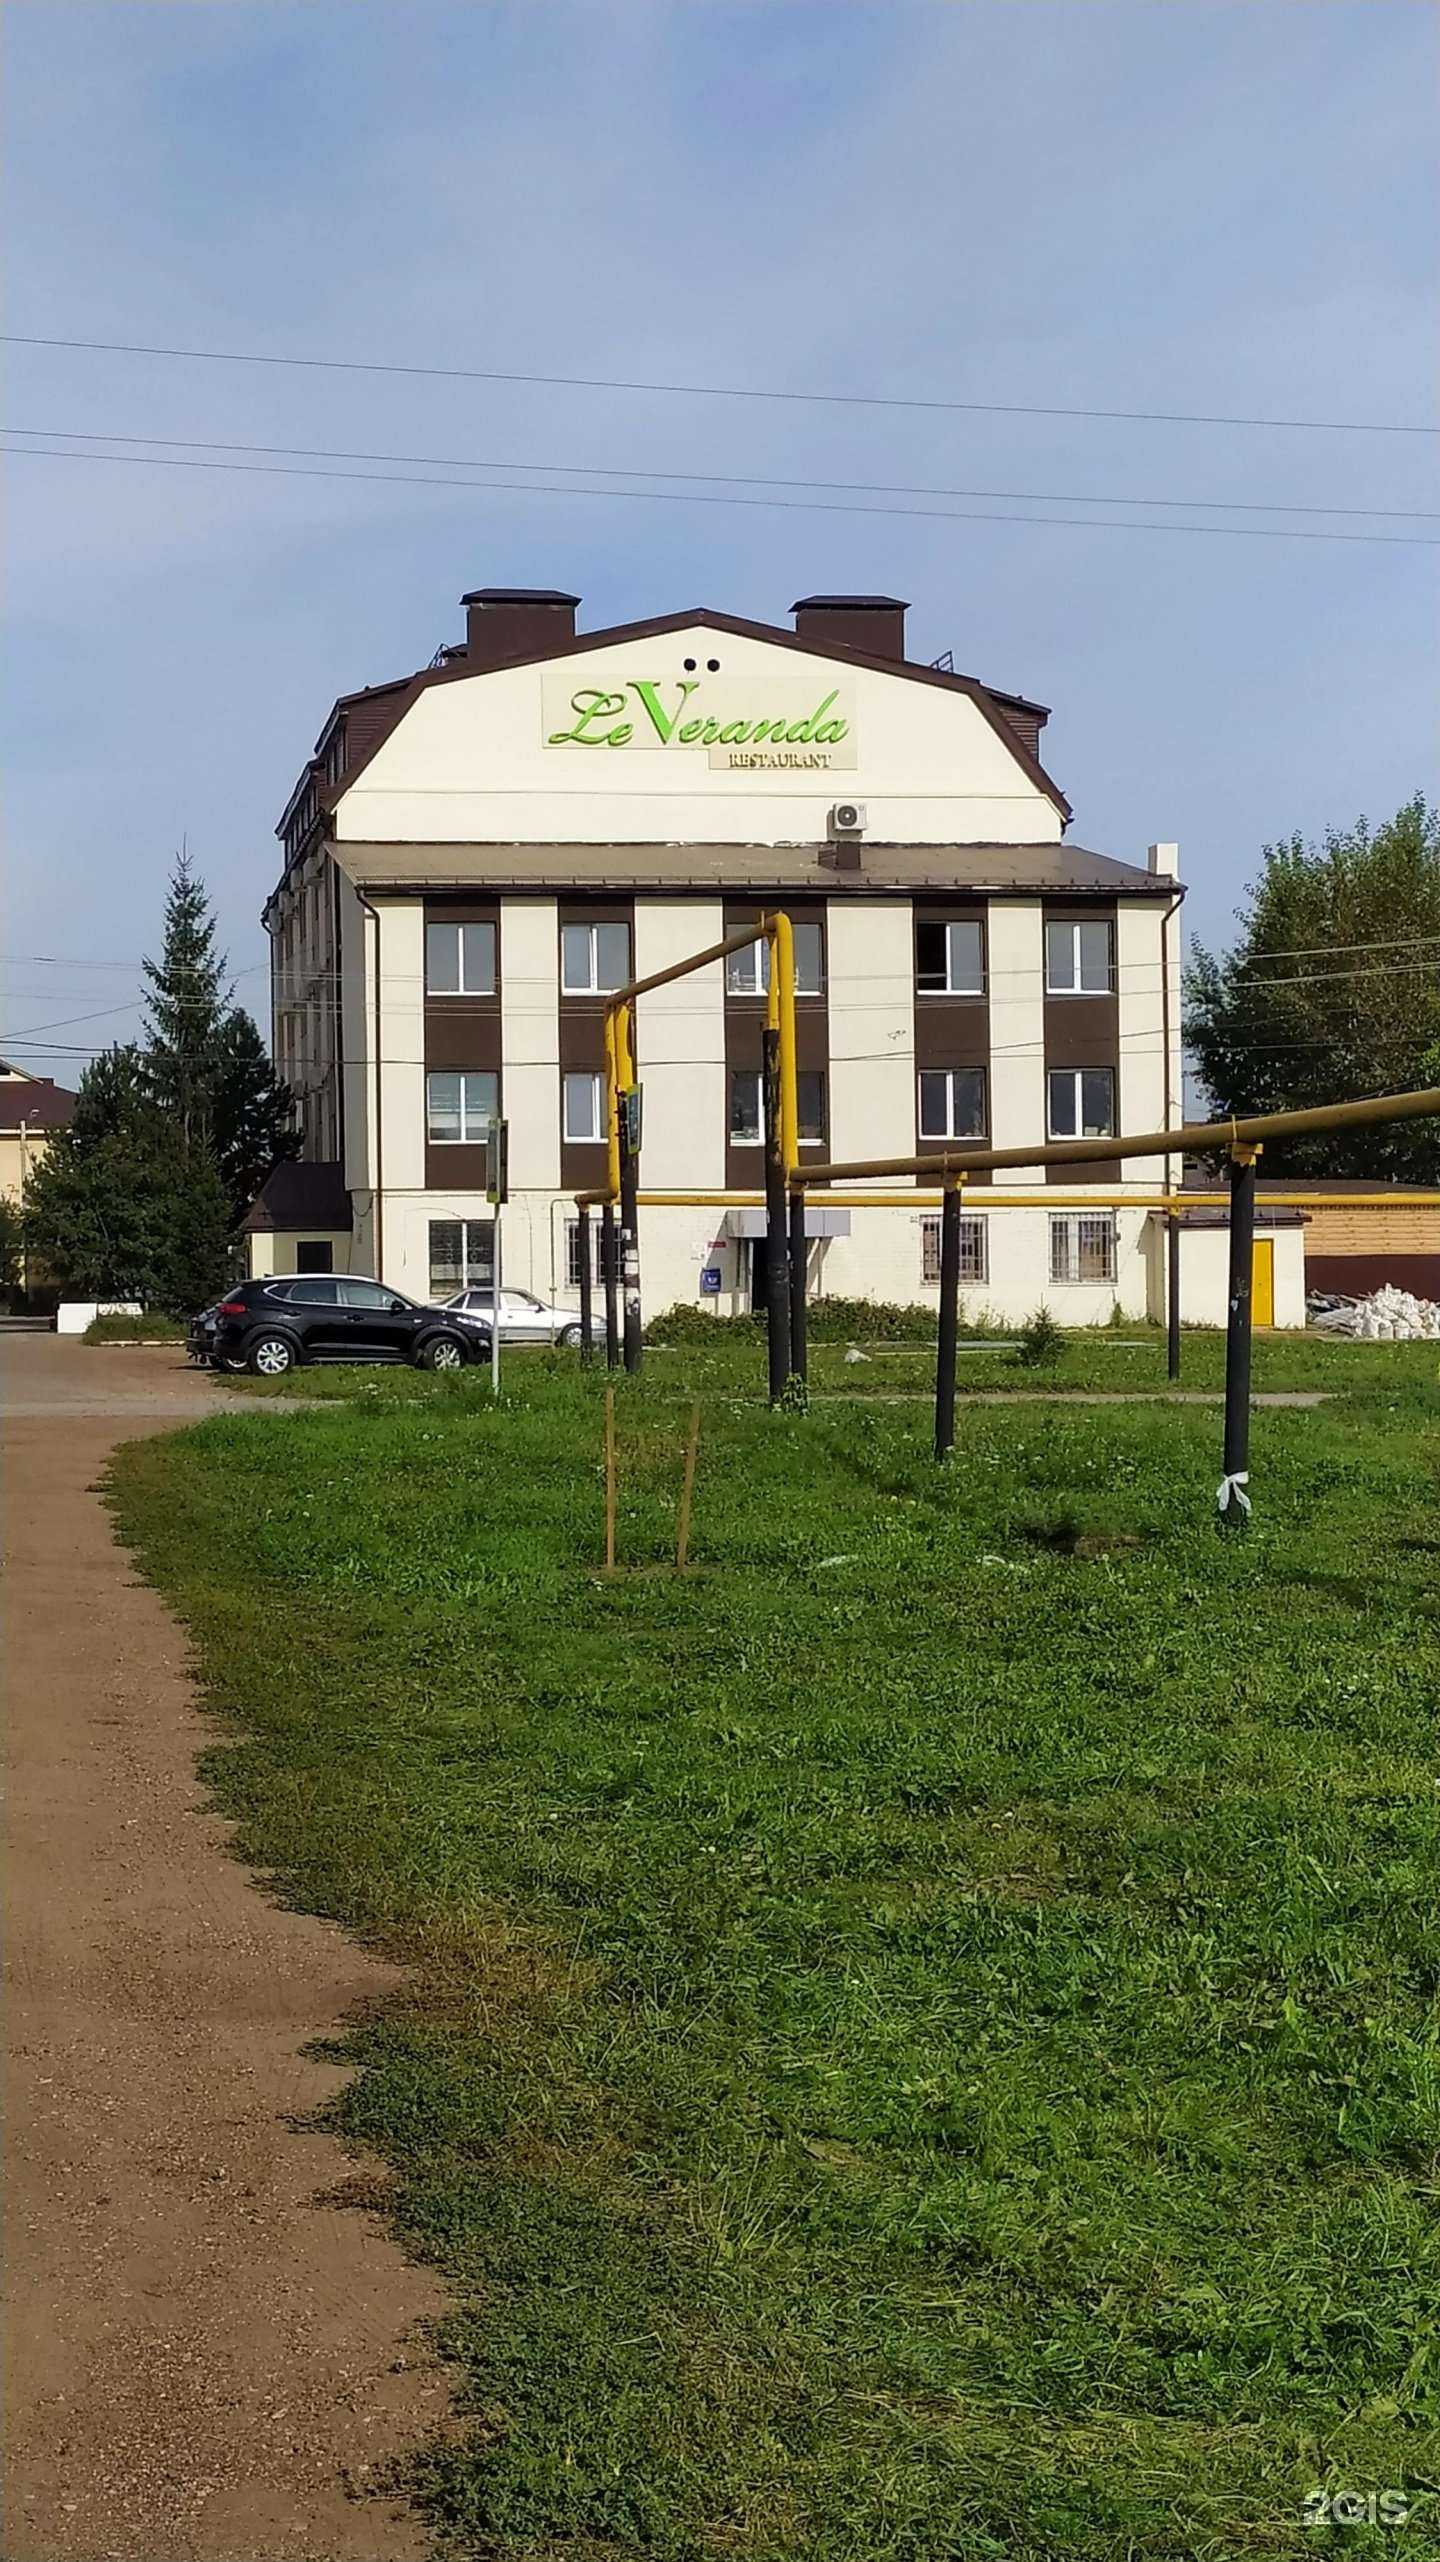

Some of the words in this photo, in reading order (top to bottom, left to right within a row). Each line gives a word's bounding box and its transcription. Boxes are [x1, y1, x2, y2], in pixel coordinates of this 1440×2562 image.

[549, 690, 633, 746] Le
[626, 681, 849, 745] Veranda
[729, 753, 832, 768] RESTAURANT
